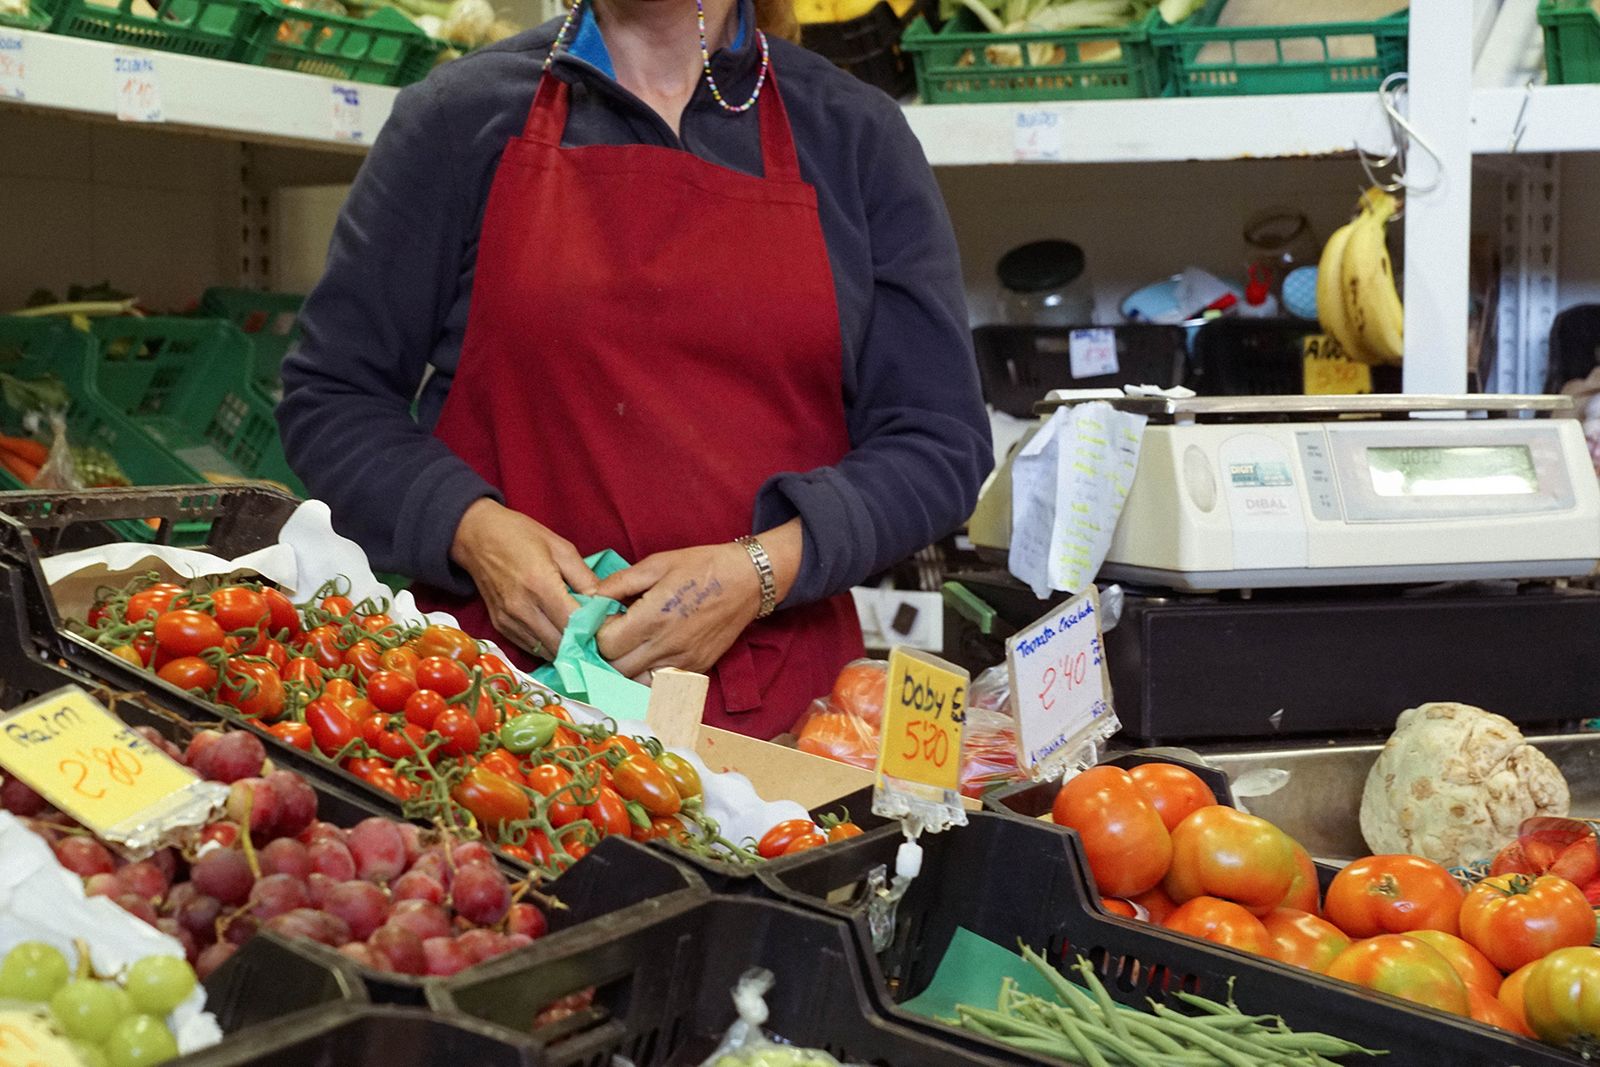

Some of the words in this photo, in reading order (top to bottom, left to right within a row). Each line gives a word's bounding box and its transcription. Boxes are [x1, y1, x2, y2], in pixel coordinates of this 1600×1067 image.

[1245, 498, 1288, 510] DIBAL
[1038, 651, 1087, 711] 2'40
[902, 720, 949, 768] 5'20
[59, 746, 143, 800] 2'80
